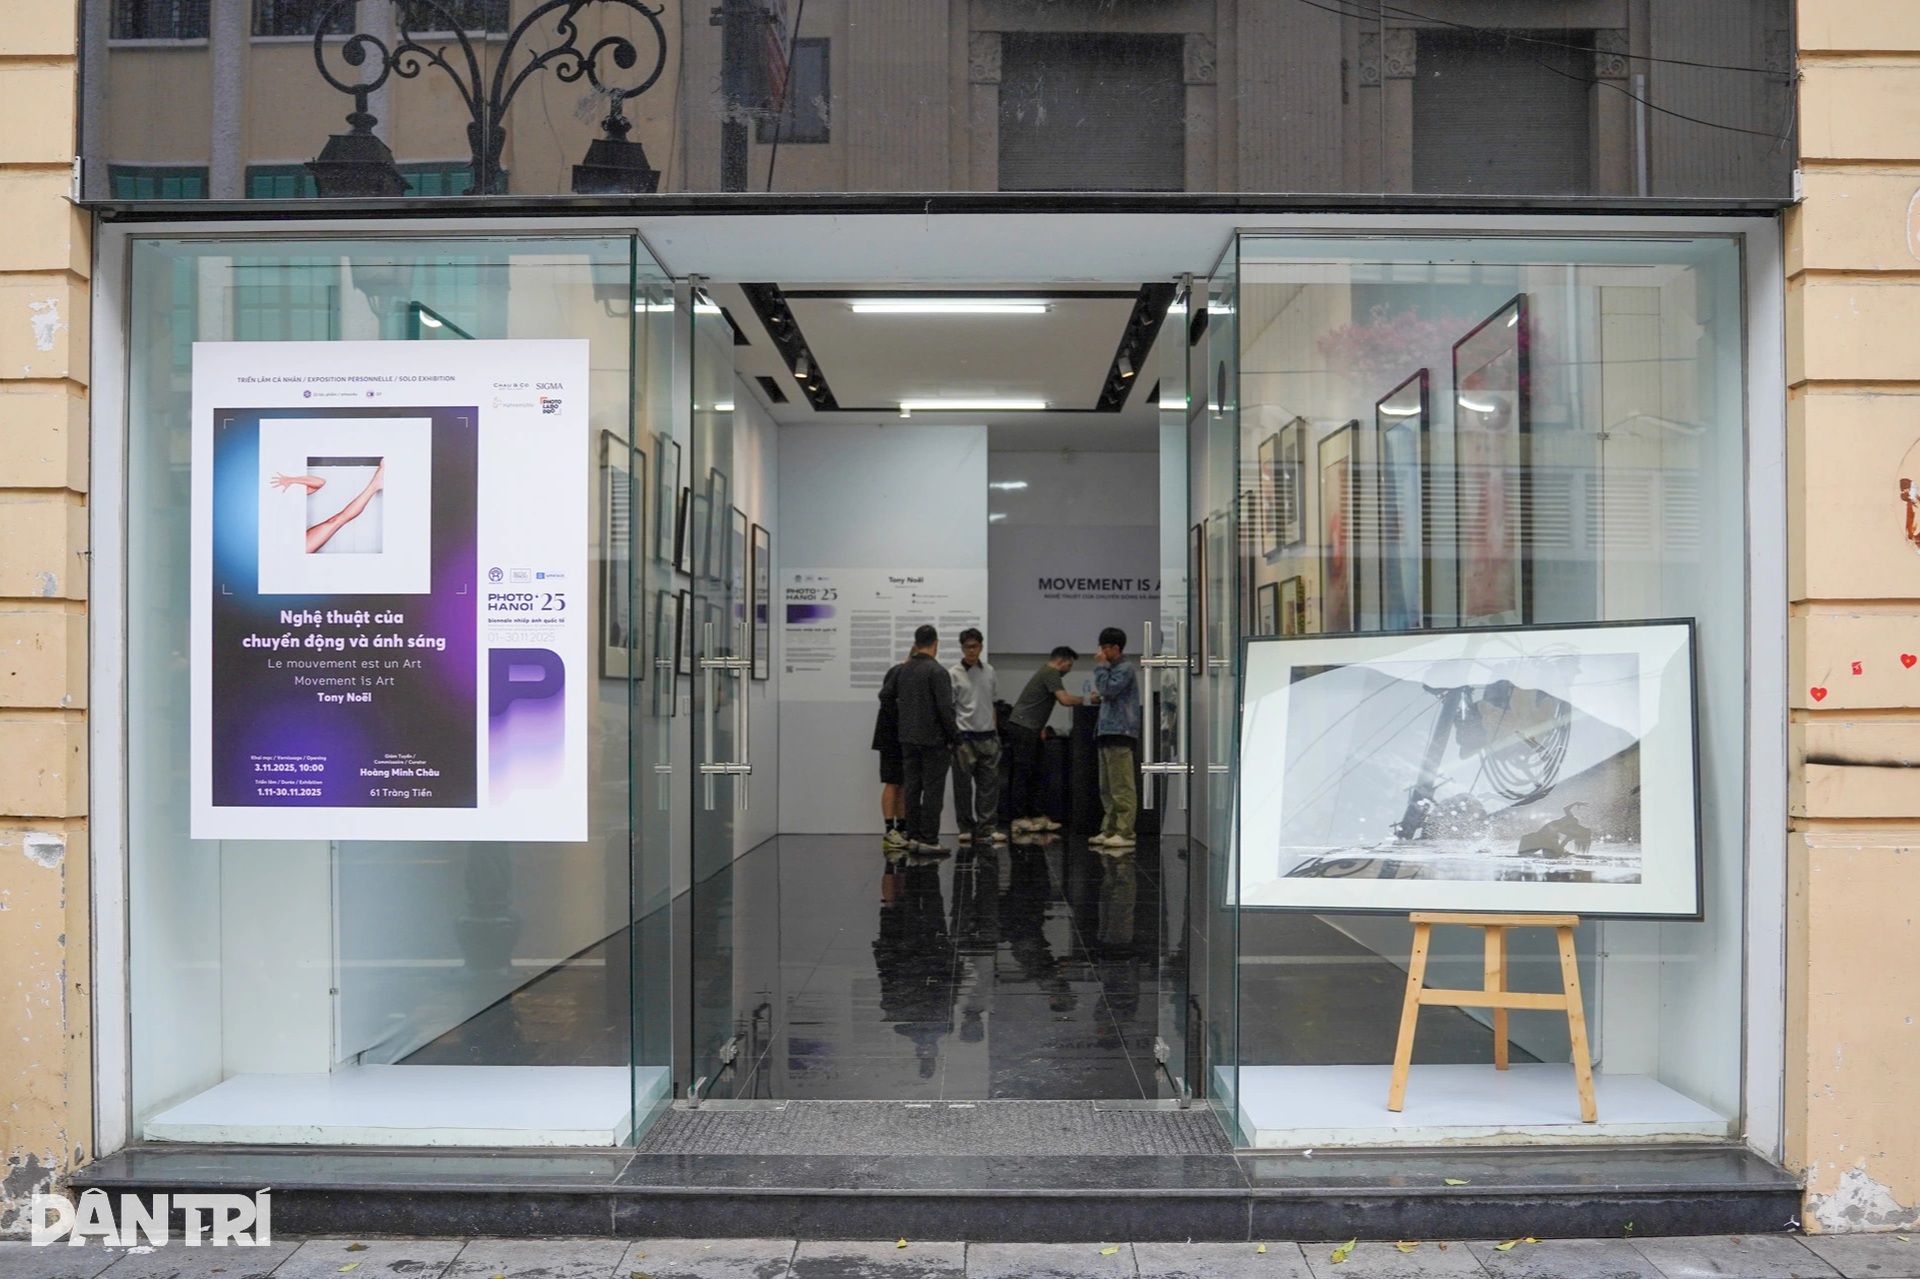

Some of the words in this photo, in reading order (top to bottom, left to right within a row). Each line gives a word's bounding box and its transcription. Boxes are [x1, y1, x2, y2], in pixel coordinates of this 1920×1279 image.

[889, 576, 905, 584] Tony
[1039, 578, 1133, 591] MOVEMENT
[1137, 579, 1151, 591] IS
[488, 593, 533, 601] PHOTO
[488, 603, 533, 611] HANOI
[281, 610, 322, 628] Nghệ
[327, 610, 370, 628] thuật
[374, 610, 404, 624] của
[243, 632, 300, 651] chuyển
[304, 634, 345, 652] động
[350, 634, 368, 648] và
[373, 634, 403, 648] ánh
[407, 634, 446, 651] sáng
[268, 659, 282, 669] Le
[287, 660, 357, 669] mouvement
[361, 660, 380, 669] est
[384, 661, 399, 669] un
[403, 659, 422, 669] Art
[294, 676, 356, 686] Movement
[361, 676, 372, 686] is
[376, 676, 395, 686] Art
[318, 692, 344, 704] Tony
[347, 692, 372, 702] Noël
[255, 764, 297, 773] 3.11.2025,
[299, 764, 324, 772] 10:00
[360, 768, 390, 778] Hoàng
[392, 768, 414, 776] Minh
[416, 768, 440, 776] Châu
[257, 788, 322, 796] 1.11-30.11.2025
[370, 788, 380, 797] 61
[382, 788, 410, 798] Tràng
